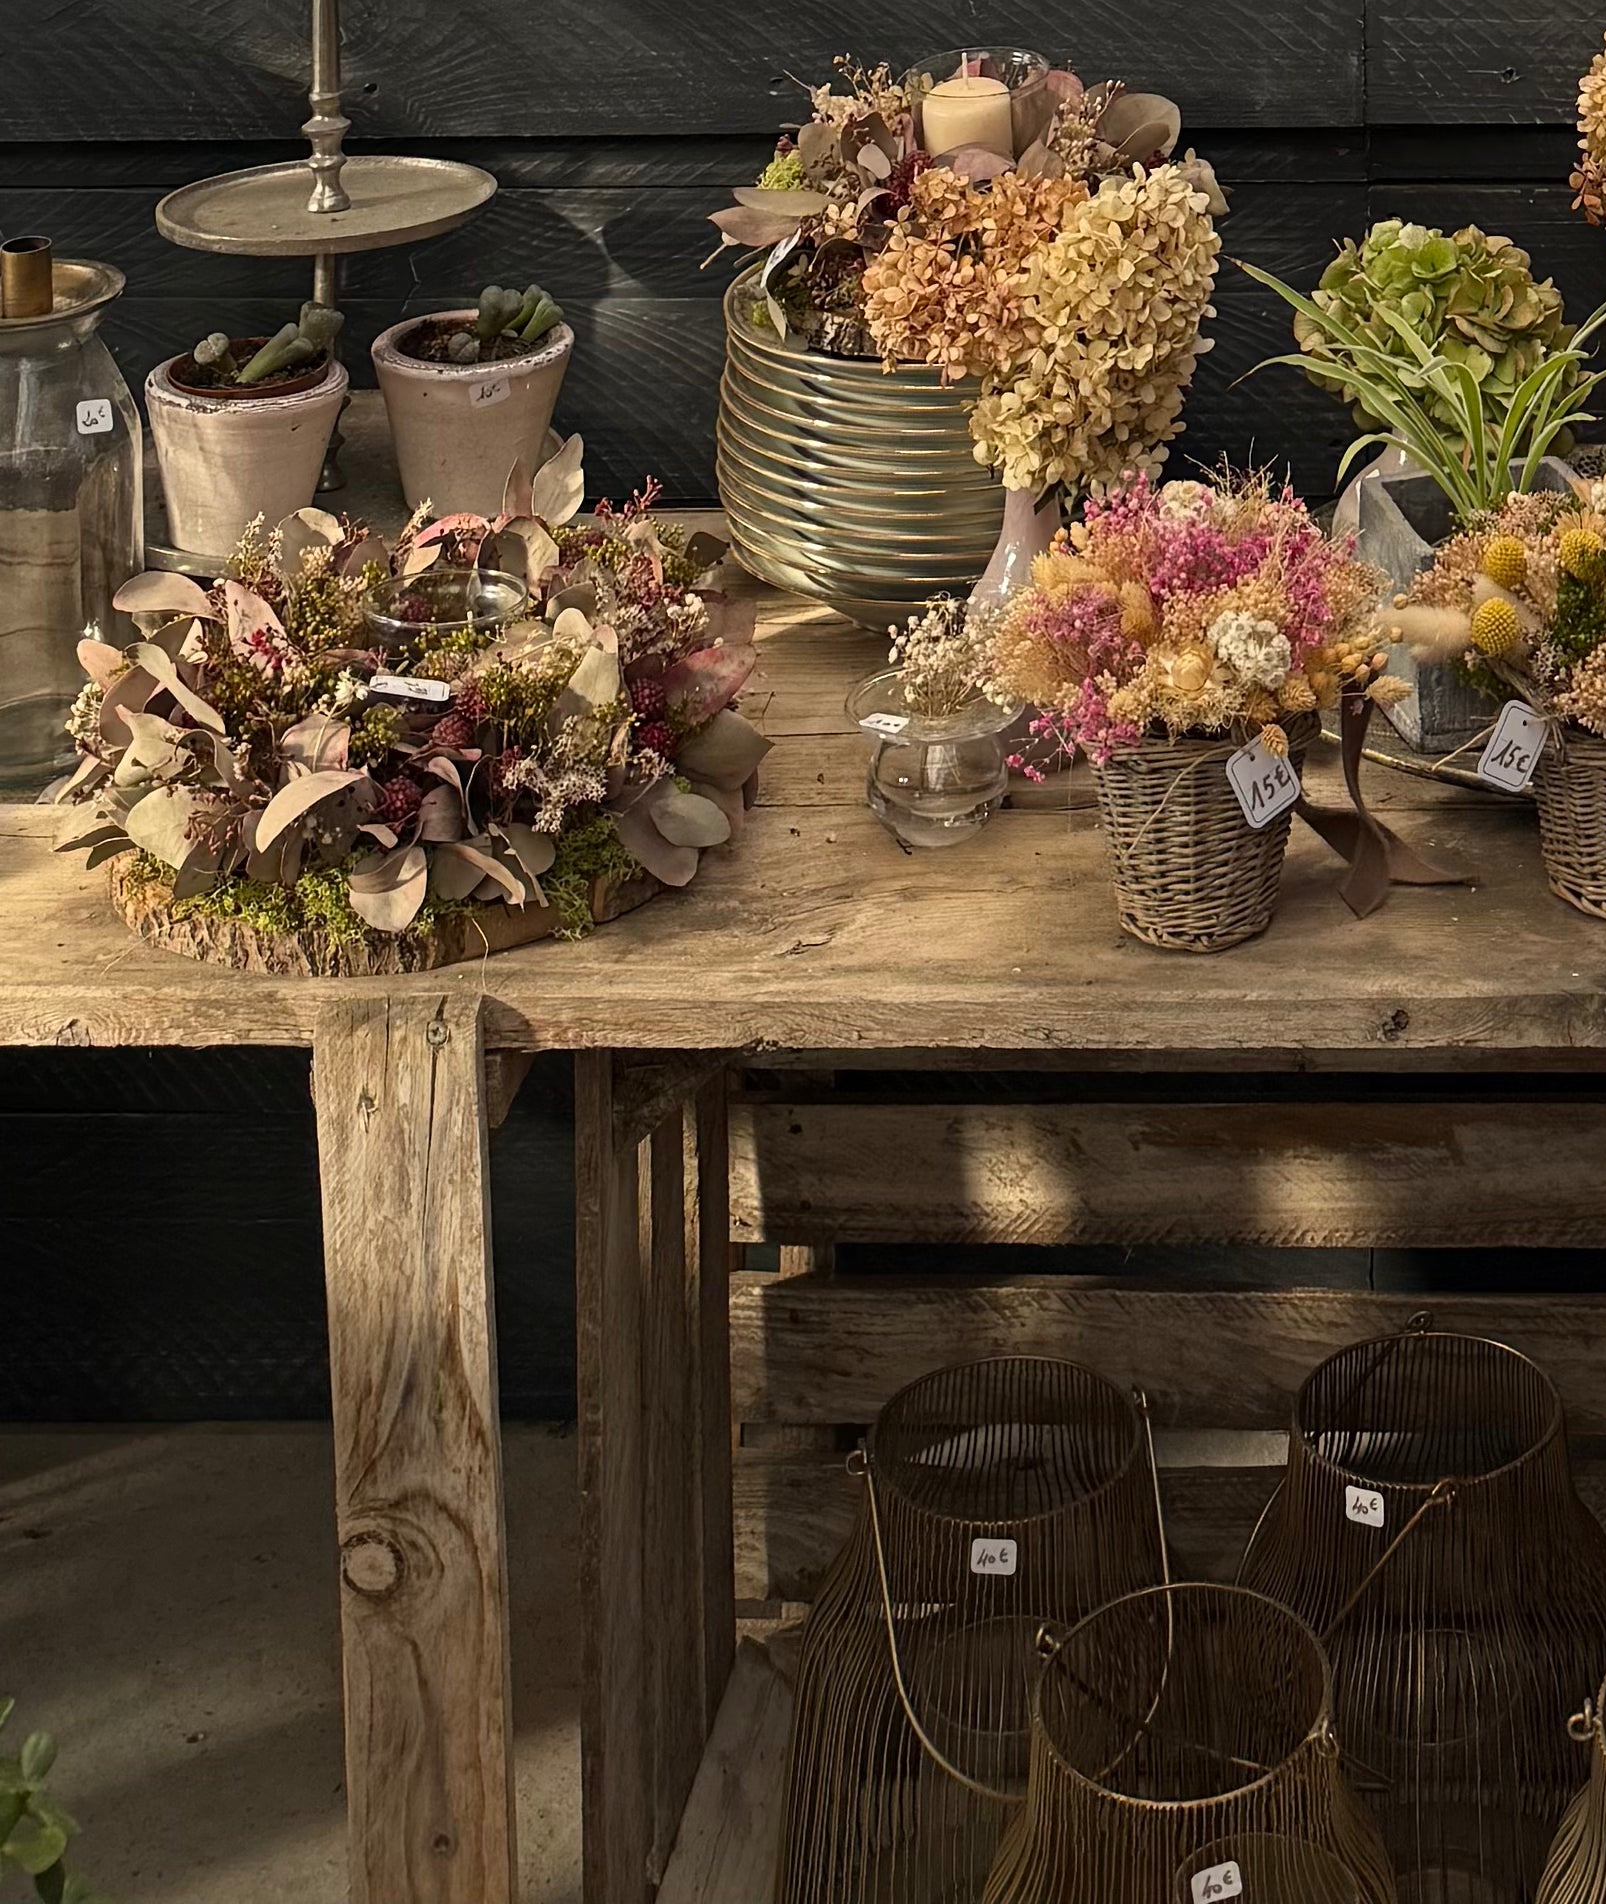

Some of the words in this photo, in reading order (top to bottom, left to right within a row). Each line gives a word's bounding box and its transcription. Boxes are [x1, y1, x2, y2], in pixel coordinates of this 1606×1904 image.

[1491, 739, 1531, 774] 15€
[1251, 764, 1291, 811] 15€
[1352, 1495, 1378, 1515] 40€
[977, 1547, 1009, 1568] 40€
[1202, 1870, 1233, 1900] 40€
